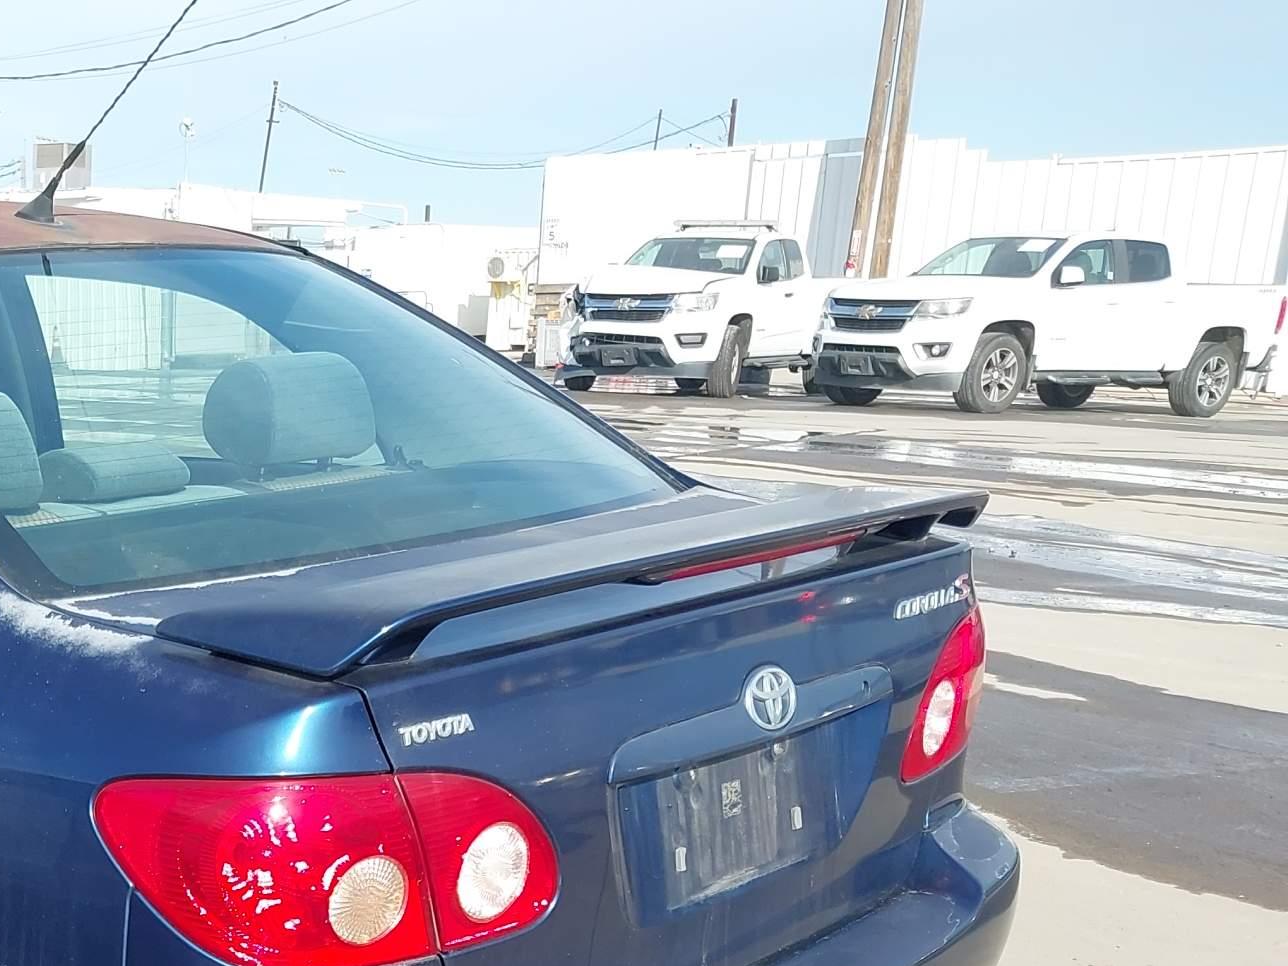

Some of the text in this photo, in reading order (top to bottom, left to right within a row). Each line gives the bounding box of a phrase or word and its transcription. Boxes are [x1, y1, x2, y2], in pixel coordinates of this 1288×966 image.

[894, 573, 970, 620] COROLLA S
[398, 713, 475, 746] TOYOTA
